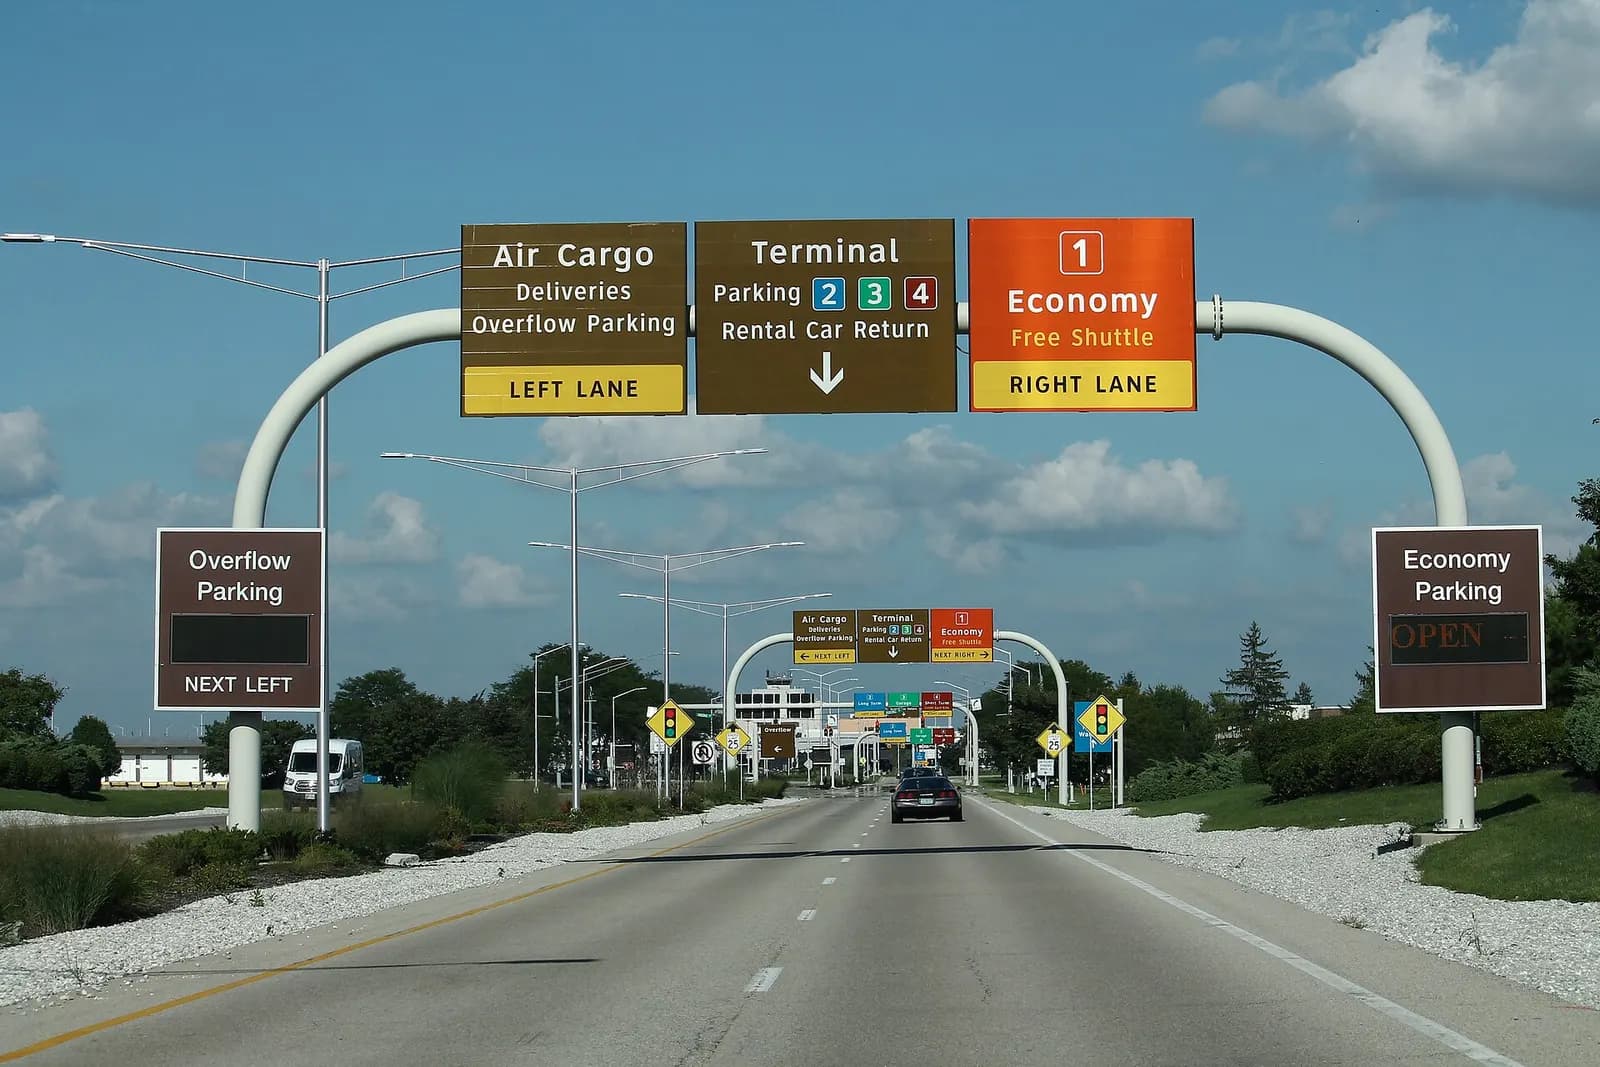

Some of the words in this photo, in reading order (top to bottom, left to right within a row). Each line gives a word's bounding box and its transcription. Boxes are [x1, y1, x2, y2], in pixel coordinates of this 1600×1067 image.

[493, 242, 539, 267] Air
[557, 243, 654, 273] Cargo
[751, 238, 899, 264] Terminal
[1072, 238, 1087, 267] 1
[516, 281, 631, 301] Deliveries
[713, 282, 801, 307] Parking
[821, 283, 837, 305] 2
[867, 282, 883, 305] 3
[912, 282, 930, 305] 4
[1008, 289, 1158, 319] Economy
[472, 313, 576, 334] Overflow
[587, 312, 676, 337] Parking
[722, 321, 796, 340] Rental
[805, 321, 843, 340] Car
[854, 320, 929, 339] Return
[1011, 328, 1060, 347] Free
[1071, 327, 1154, 347] Shuttle
[509, 380, 564, 399] LEFT
[576, 379, 638, 398] LANE
[1010, 375, 1082, 394] RIGHT
[1095, 375, 1157, 393] LANE
[189, 549, 291, 570] Overflow
[1404, 549, 1511, 573] Economy
[197, 581, 283, 606] Parking
[1415, 581, 1502, 605] Parking
[801, 615, 816, 624] Air
[819, 615, 847, 624] Cargo
[872, 613, 914, 622] Terminal
[828, 634, 853, 643] Parking
[862, 626, 887, 634] Parking
[941, 628, 983, 637] Economy
[1392, 622, 1485, 648] OPEN
[954, 651, 975, 659] RIGHT
[185, 676, 237, 692] NEXT
[246, 676, 293, 693] LEFT
[728, 739, 739, 749] 25
[1048, 740, 1059, 750] 25
